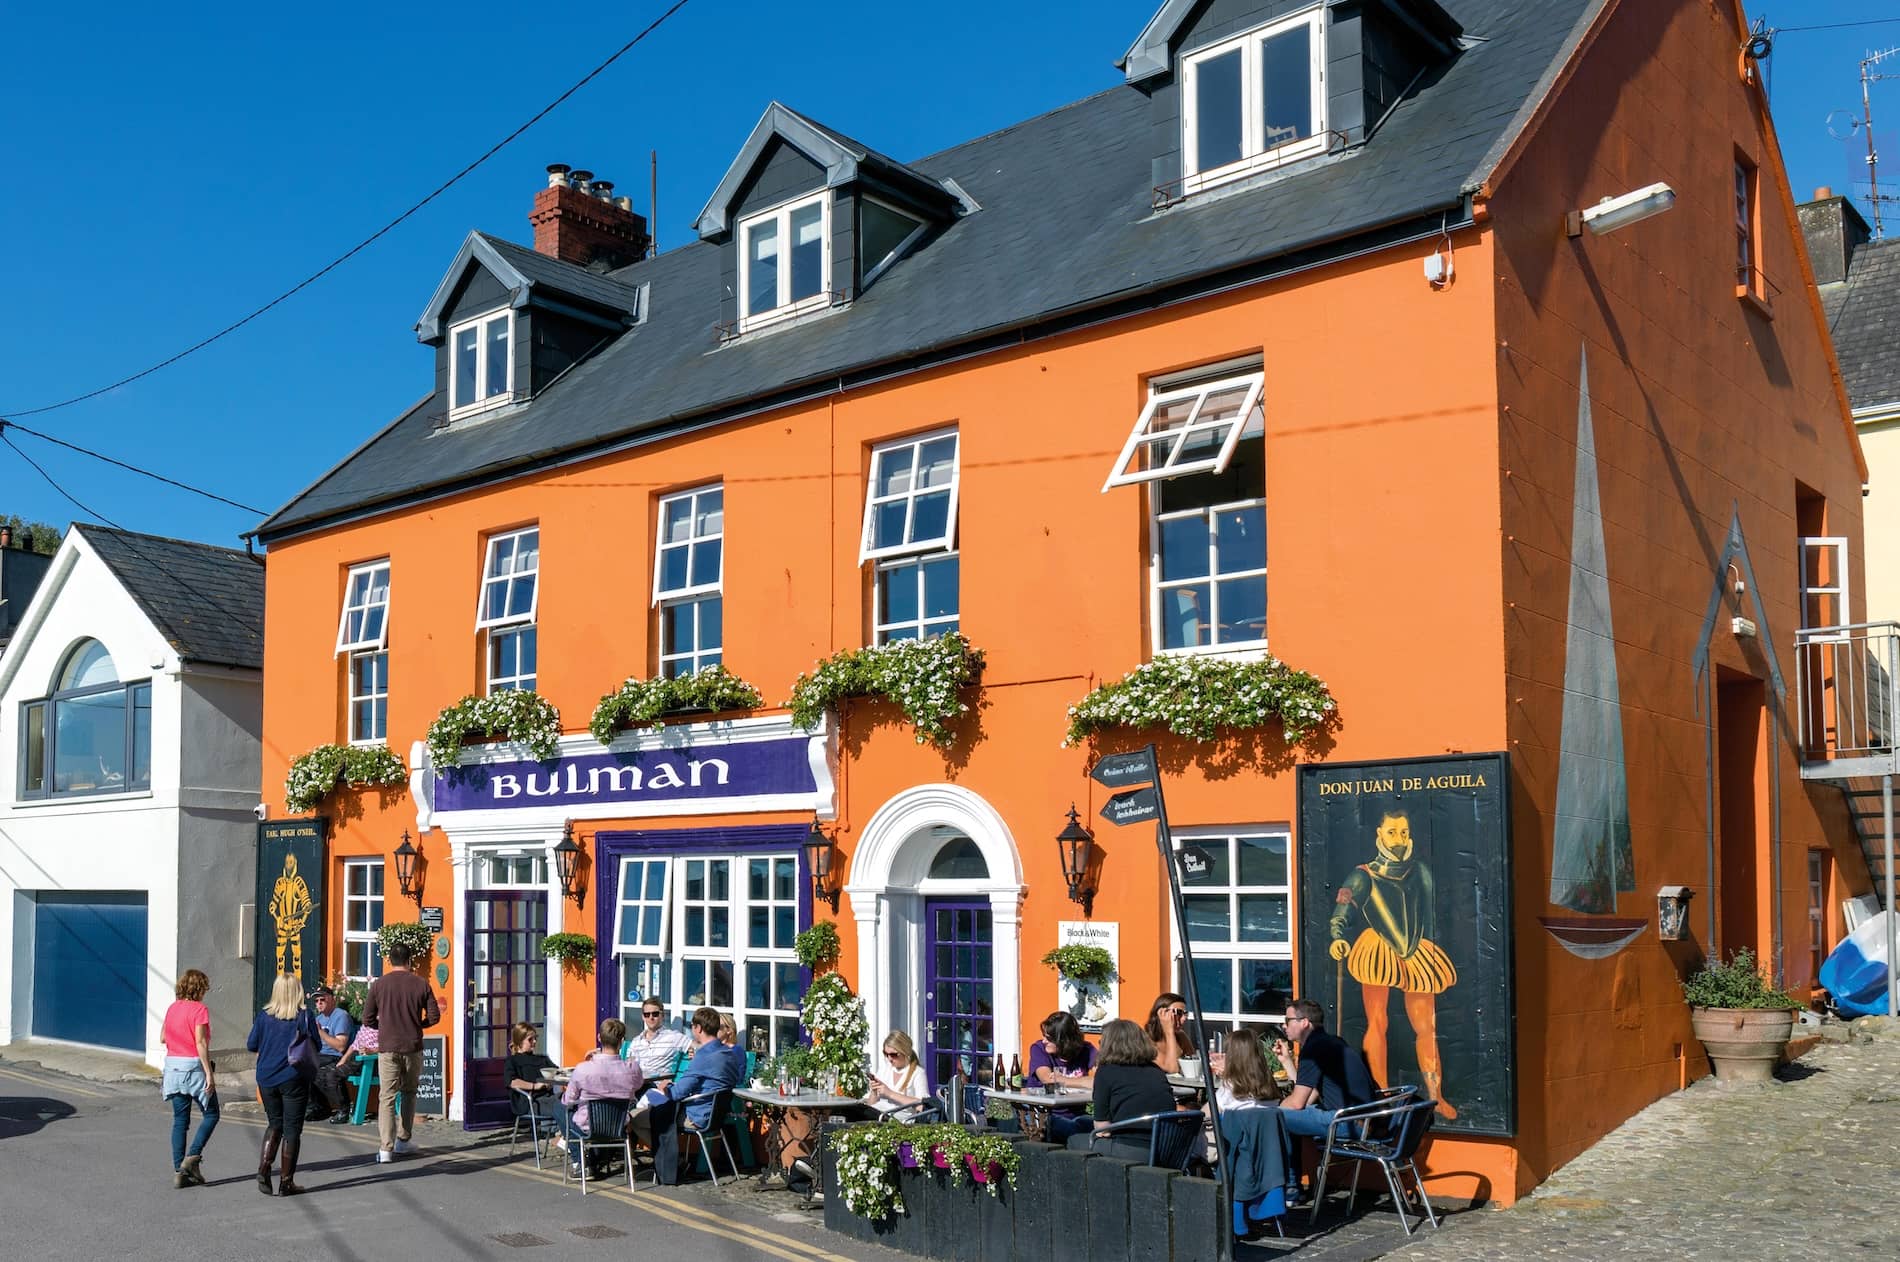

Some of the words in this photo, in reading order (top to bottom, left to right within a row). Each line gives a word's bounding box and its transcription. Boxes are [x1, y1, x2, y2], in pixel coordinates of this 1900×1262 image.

[1319, 782, 1353, 795] DON
[1355, 779, 1395, 795] JUAN
[1401, 777, 1423, 791] DE
[1426, 774, 1487, 790] AGUILA
